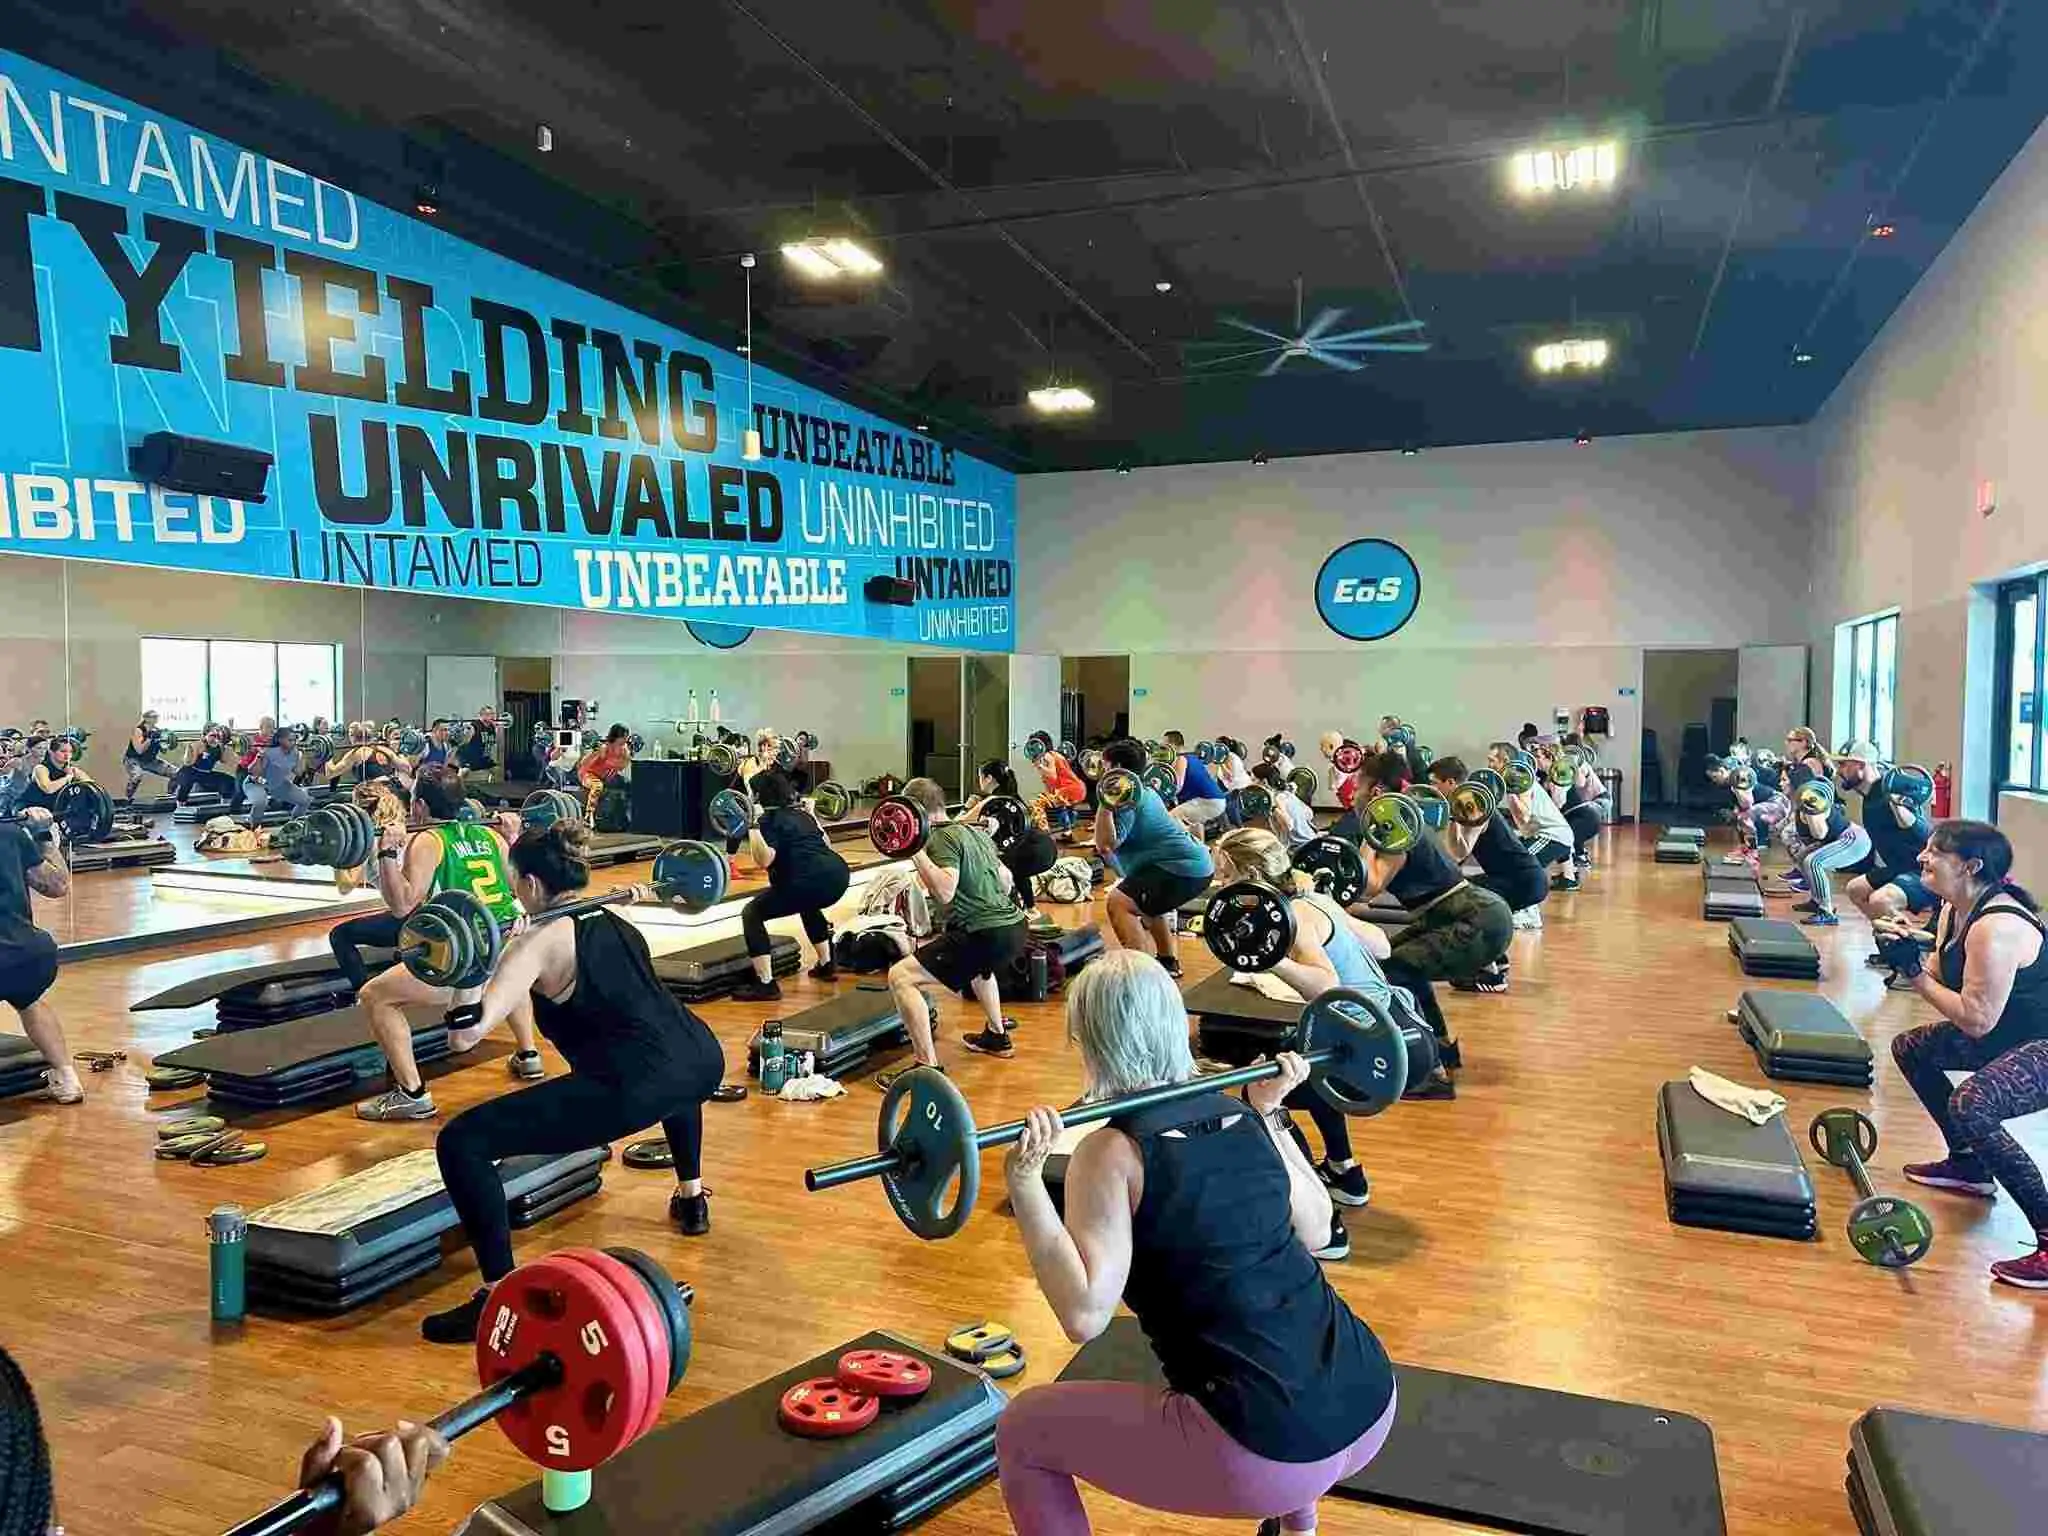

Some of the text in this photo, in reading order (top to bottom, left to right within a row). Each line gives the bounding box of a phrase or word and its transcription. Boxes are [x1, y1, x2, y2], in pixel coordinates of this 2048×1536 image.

[0, 73, 359, 250] NTAMED
[751, 403, 956, 486] UNBEATABLE
[307, 412, 783, 543] UNRIVALED
[799, 479, 995, 552] UNINHIBITED
[289, 528, 544, 588] UNTAMED
[573, 548, 848, 609] UNBEATABLE
[918, 604, 1009, 641] UNINHIBITED
[466, 860, 504, 905] 2
[1371, 1057, 1388, 1080] 10
[580, 1319, 609, 1356] 5
[545, 1424, 570, 1457] 5
